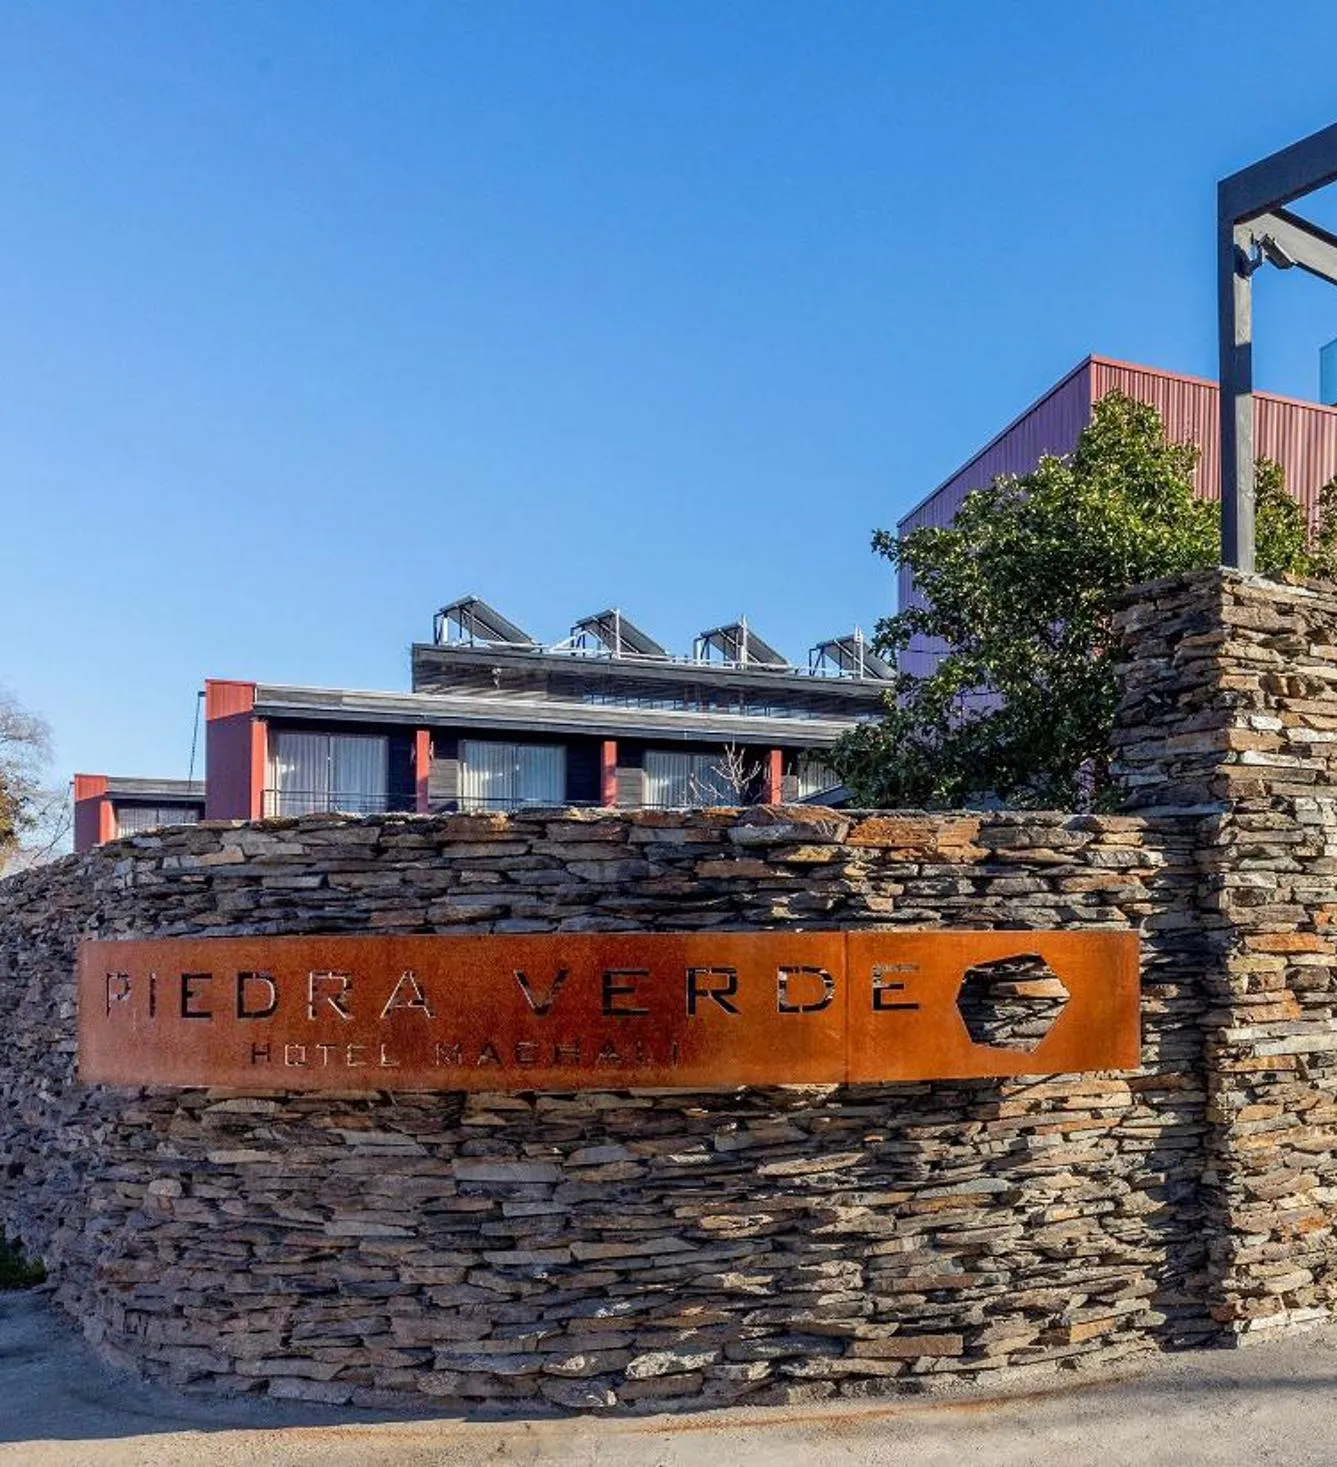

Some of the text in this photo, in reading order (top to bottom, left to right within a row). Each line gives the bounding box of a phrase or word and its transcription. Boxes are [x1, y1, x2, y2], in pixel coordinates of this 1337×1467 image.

[105, 963, 920, 1020] PIEDRA VERDE
[250, 1042, 399, 1067] HOTEL
